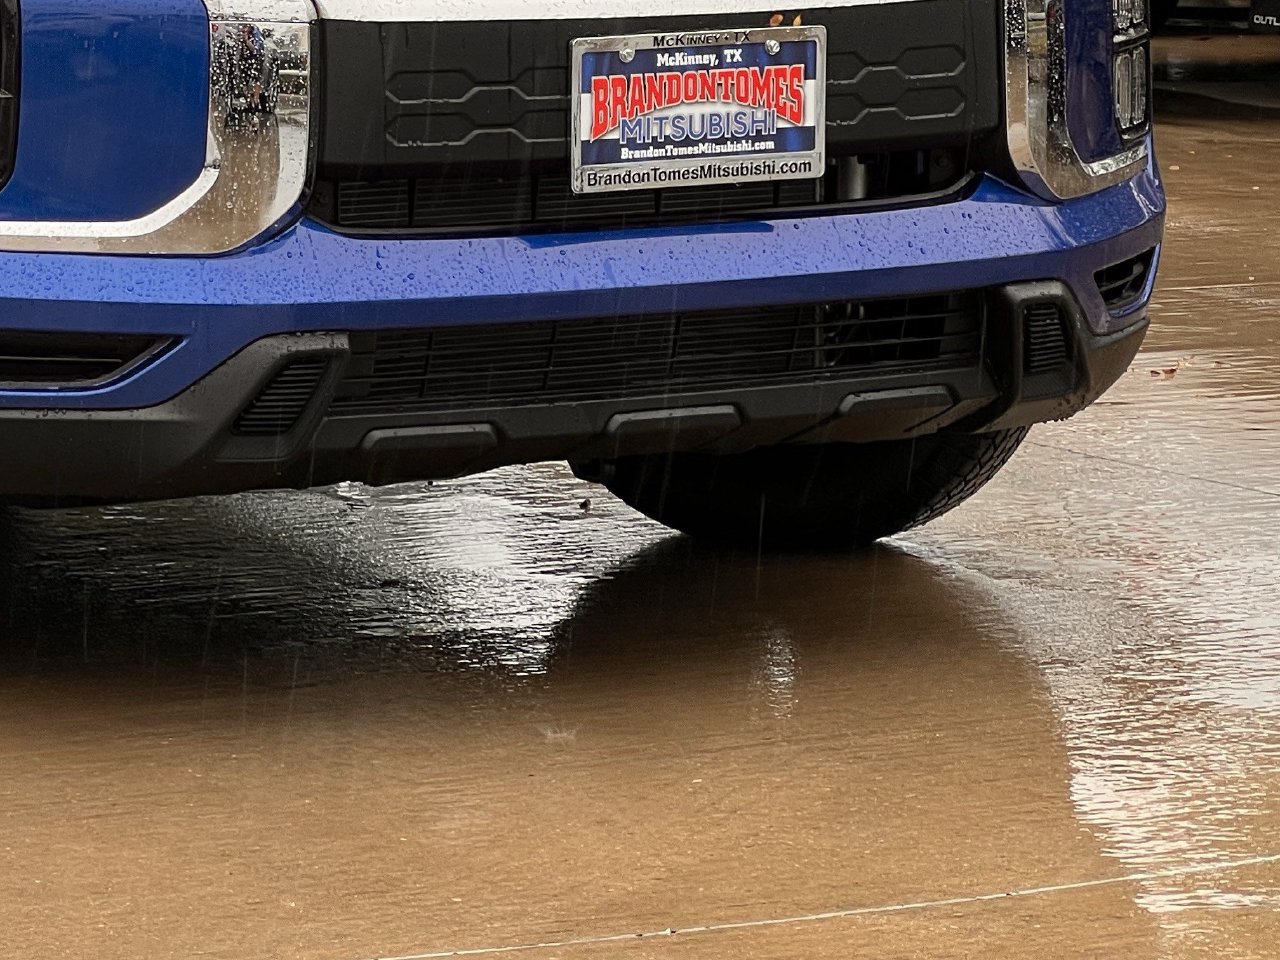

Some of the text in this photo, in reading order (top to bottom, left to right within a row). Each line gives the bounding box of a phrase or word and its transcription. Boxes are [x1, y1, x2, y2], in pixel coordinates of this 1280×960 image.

[733, 30, 752, 42] TX
[656, 48, 742, 67] McKinney, TX
[619, 107, 777, 144] MITSUBISHI
[620, 139, 775, 160] BrandonTomesMitsubishi.com
[586, 159, 812, 187] BrandonTomesMitsubishi.com
